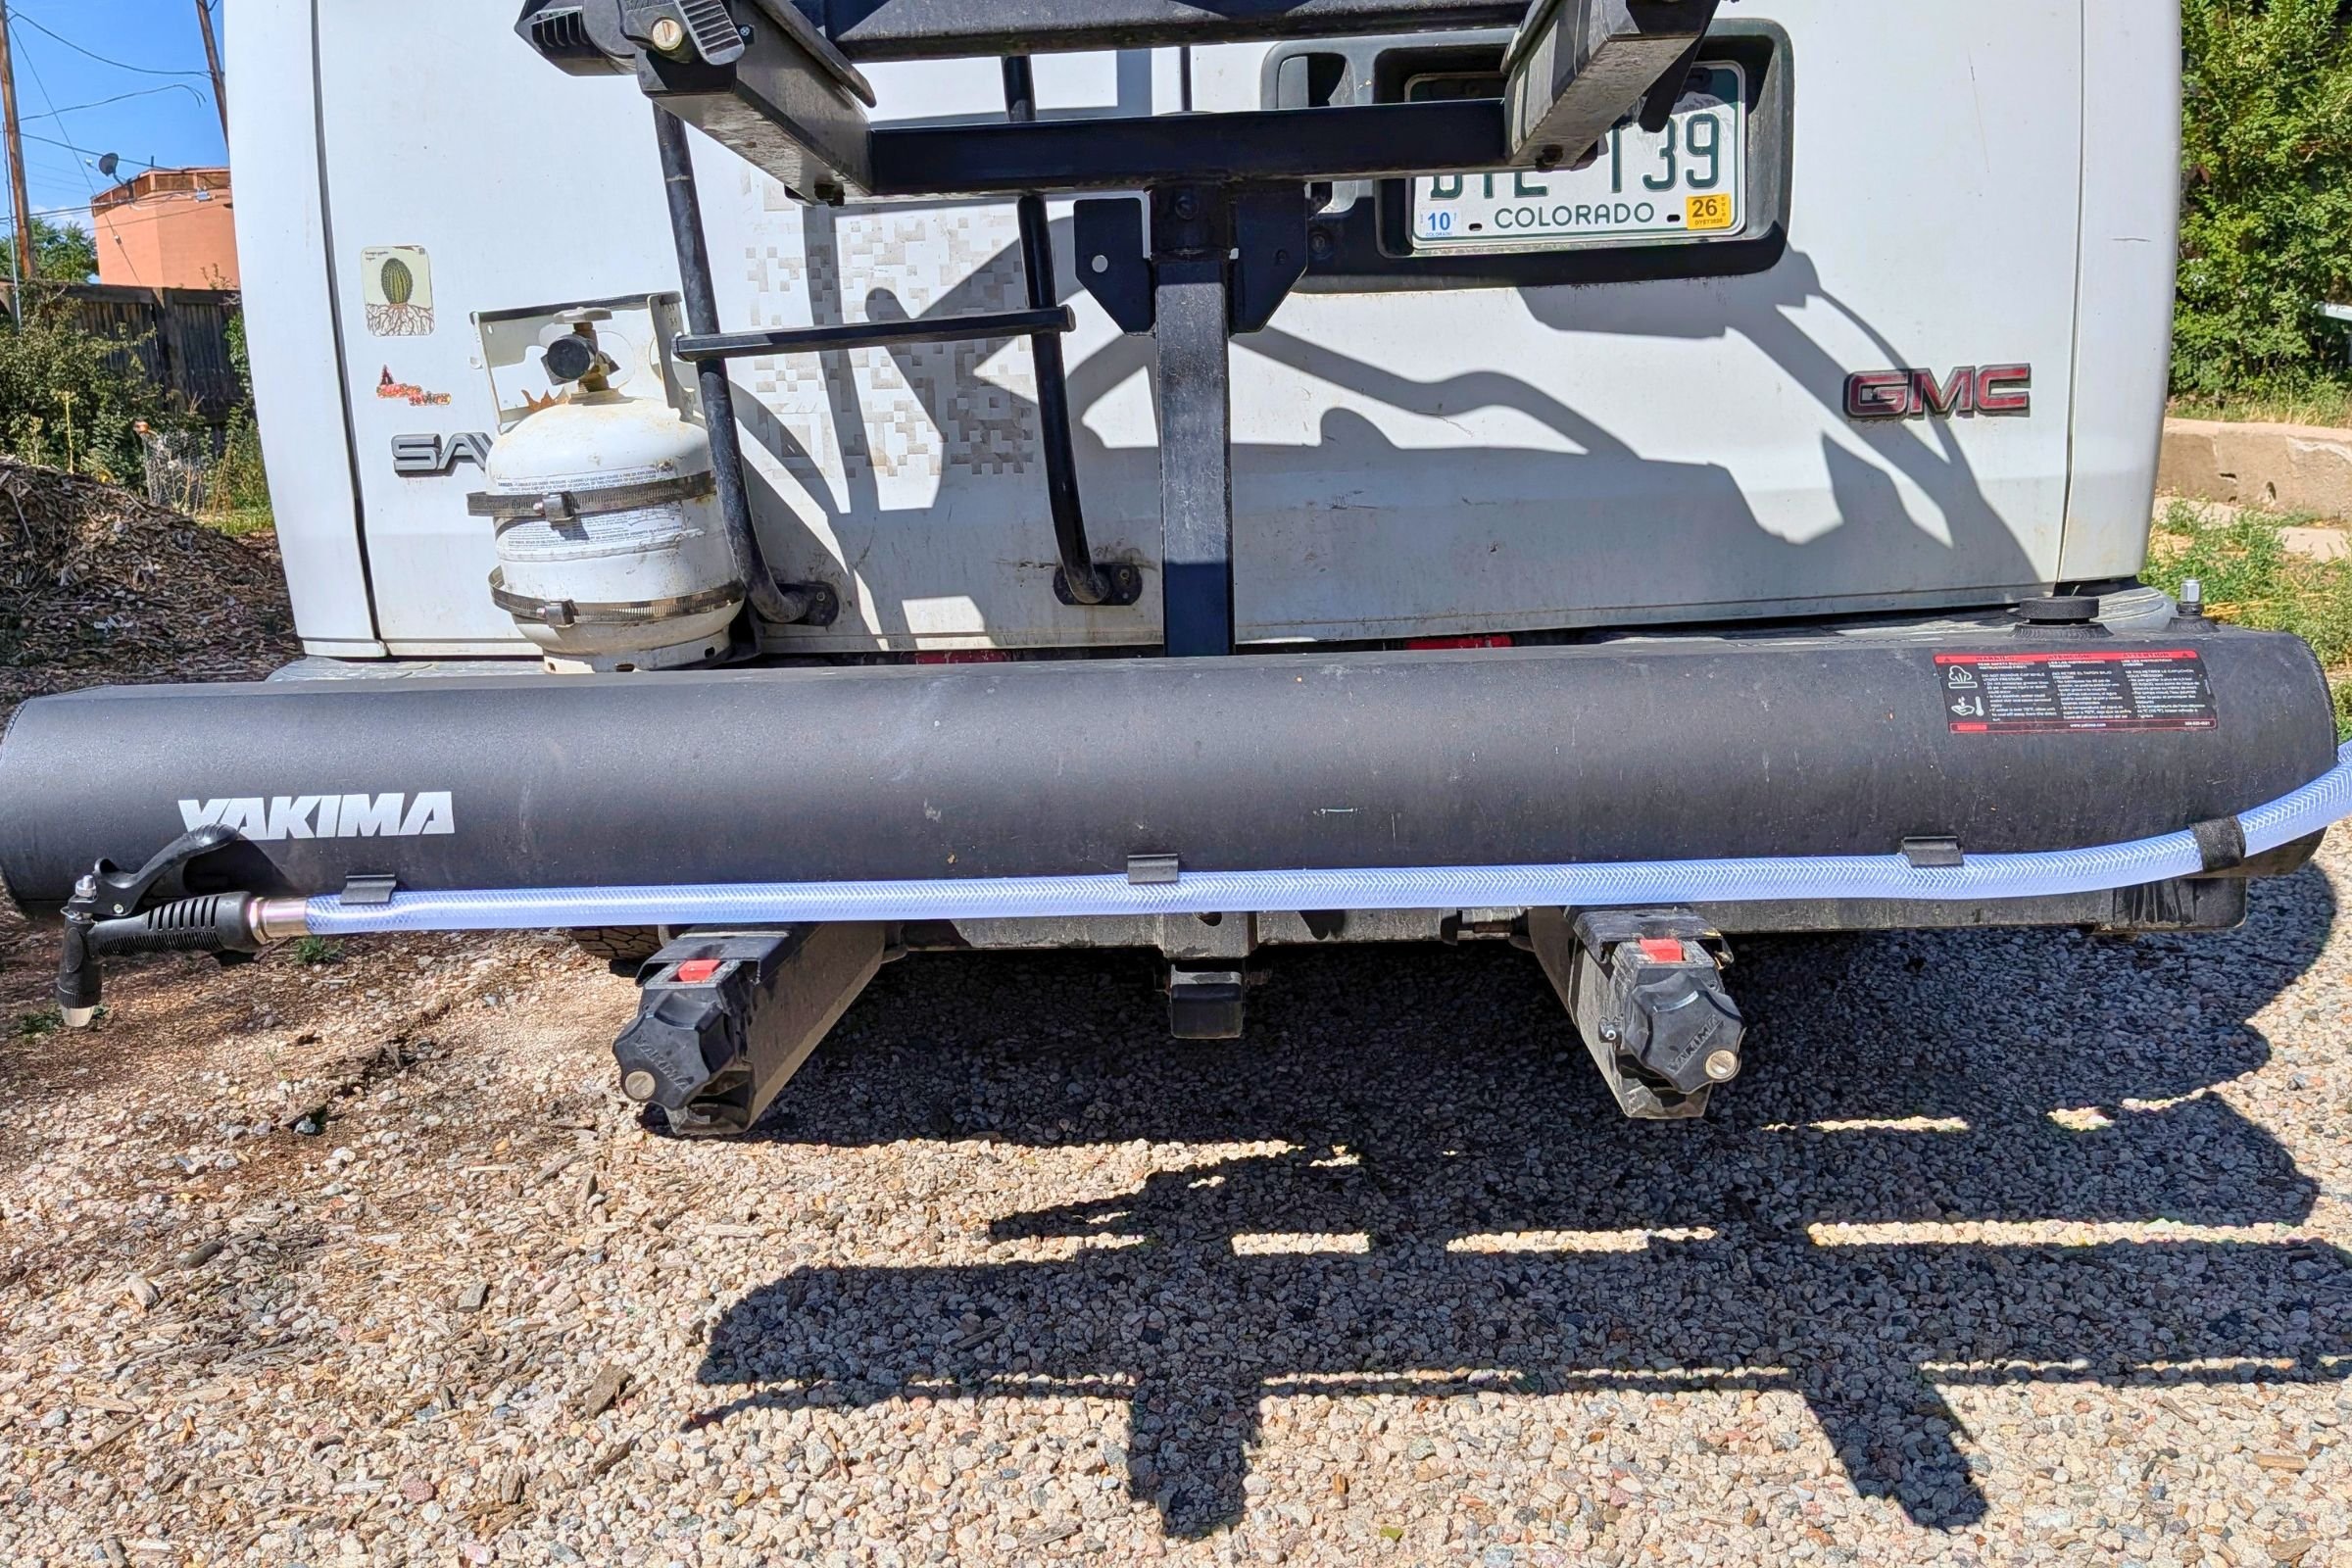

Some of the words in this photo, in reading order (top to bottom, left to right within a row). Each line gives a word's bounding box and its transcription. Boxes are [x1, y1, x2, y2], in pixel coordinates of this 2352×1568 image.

[1428, 212, 1450, 231] 10
[1494, 202, 1655, 229] COLORADO
[1692, 199, 1717, 218] 26
[1844, 364, 2031, 416] GMC
[178, 791, 455, 840] YAKIMA
[1666, 1013, 1725, 1075] YAKIMA
